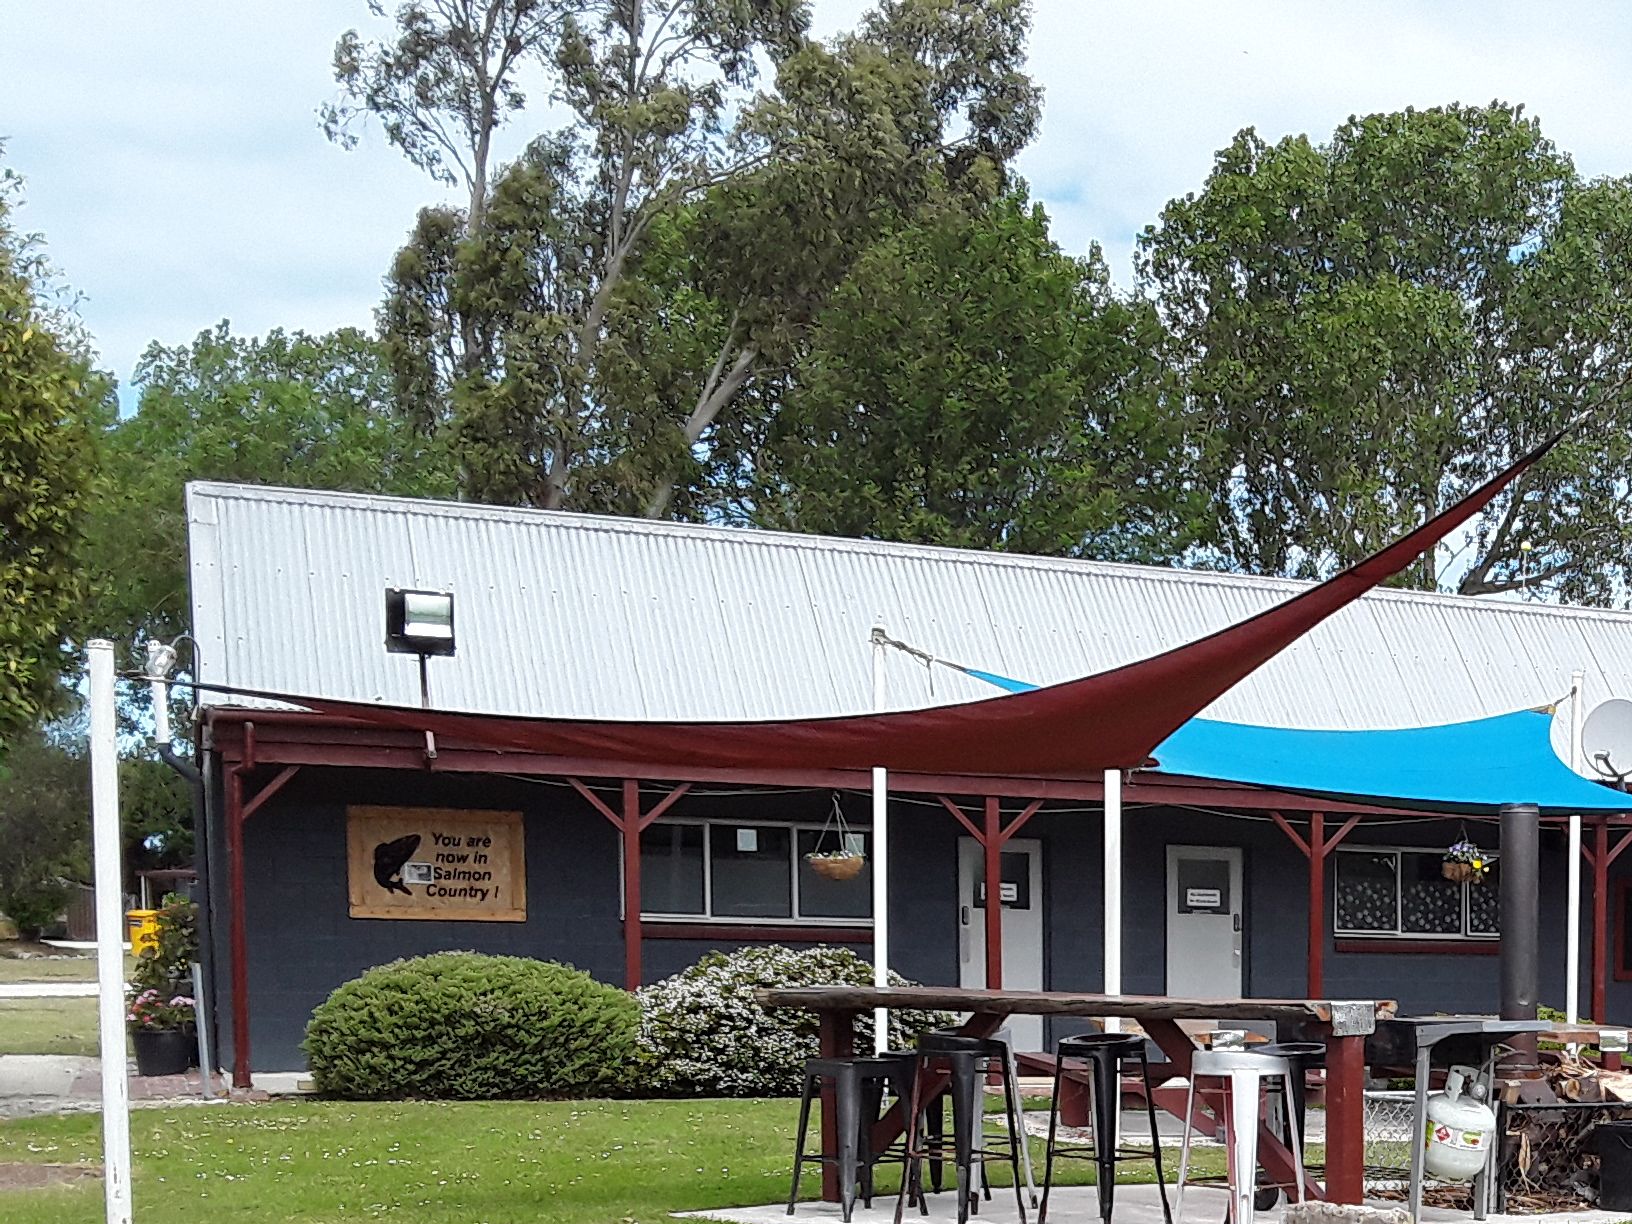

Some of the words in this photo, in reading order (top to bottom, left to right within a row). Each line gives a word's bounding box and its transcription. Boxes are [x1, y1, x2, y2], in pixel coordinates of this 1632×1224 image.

[432, 832, 461, 848] You
[467, 836, 492, 848] are
[435, 852, 469, 865] now
[474, 851, 488, 865] in
[434, 867, 492, 882] Salmon
[426, 884, 489, 901] Country
